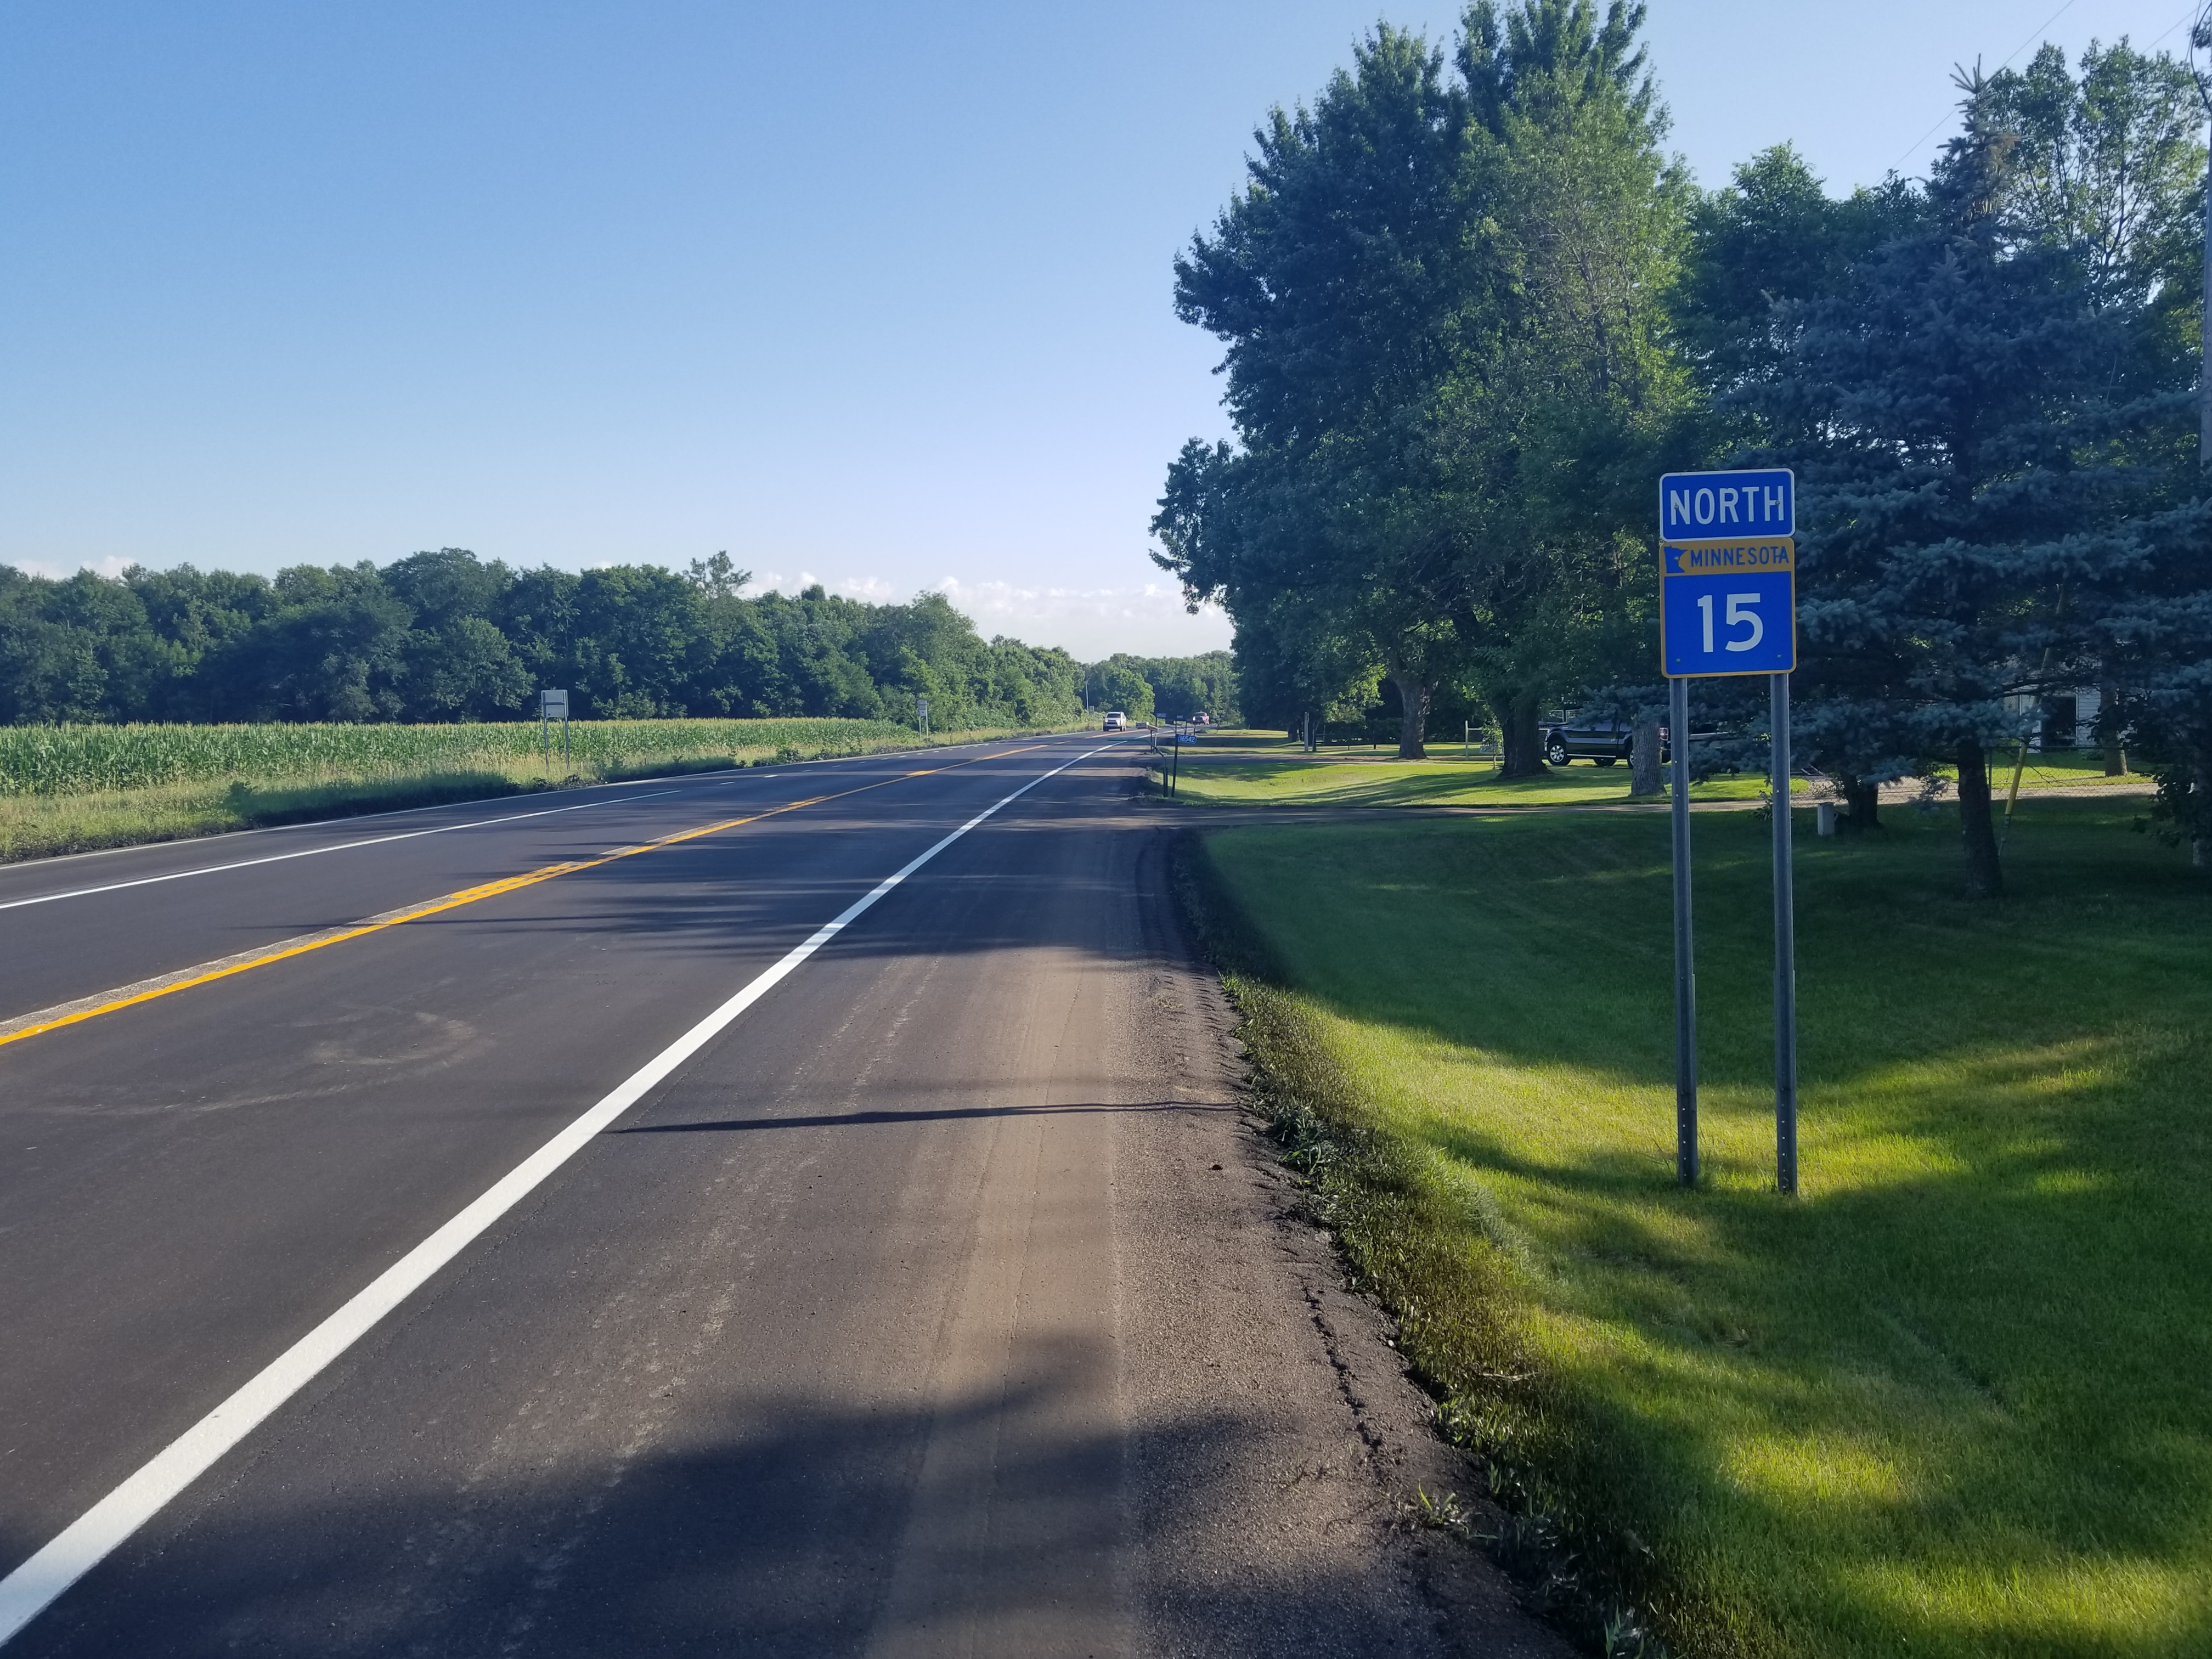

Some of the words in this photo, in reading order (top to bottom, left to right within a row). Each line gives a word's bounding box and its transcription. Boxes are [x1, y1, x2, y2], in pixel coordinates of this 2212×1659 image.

[1670, 486, 1784, 526] NORTH
[1690, 546, 1789, 567] MINNESOTA
[1697, 593, 1763, 653] 15
